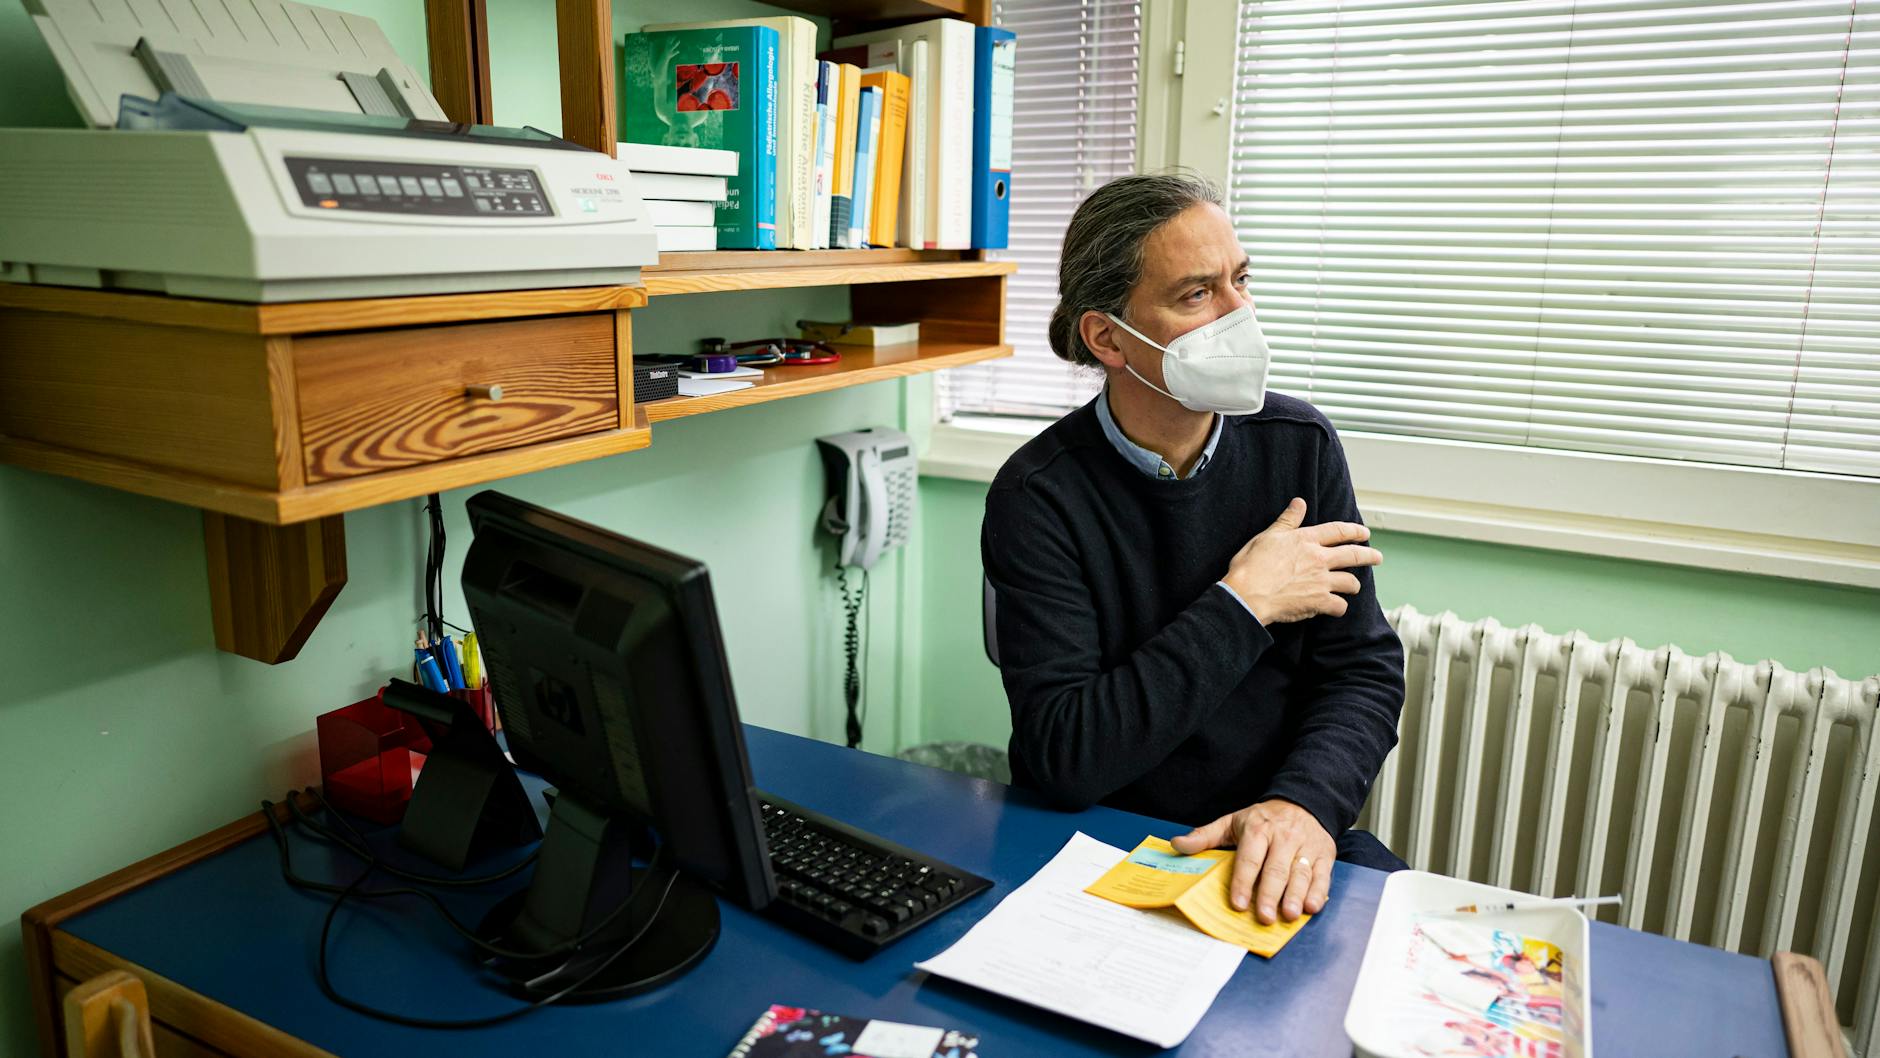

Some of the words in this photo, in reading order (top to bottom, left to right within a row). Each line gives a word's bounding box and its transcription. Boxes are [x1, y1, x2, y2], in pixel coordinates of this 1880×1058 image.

[767, 46, 775, 101] Allergologie
[766, 102, 774, 155] Pädiatrische
[801, 81, 811, 152] Klinische
